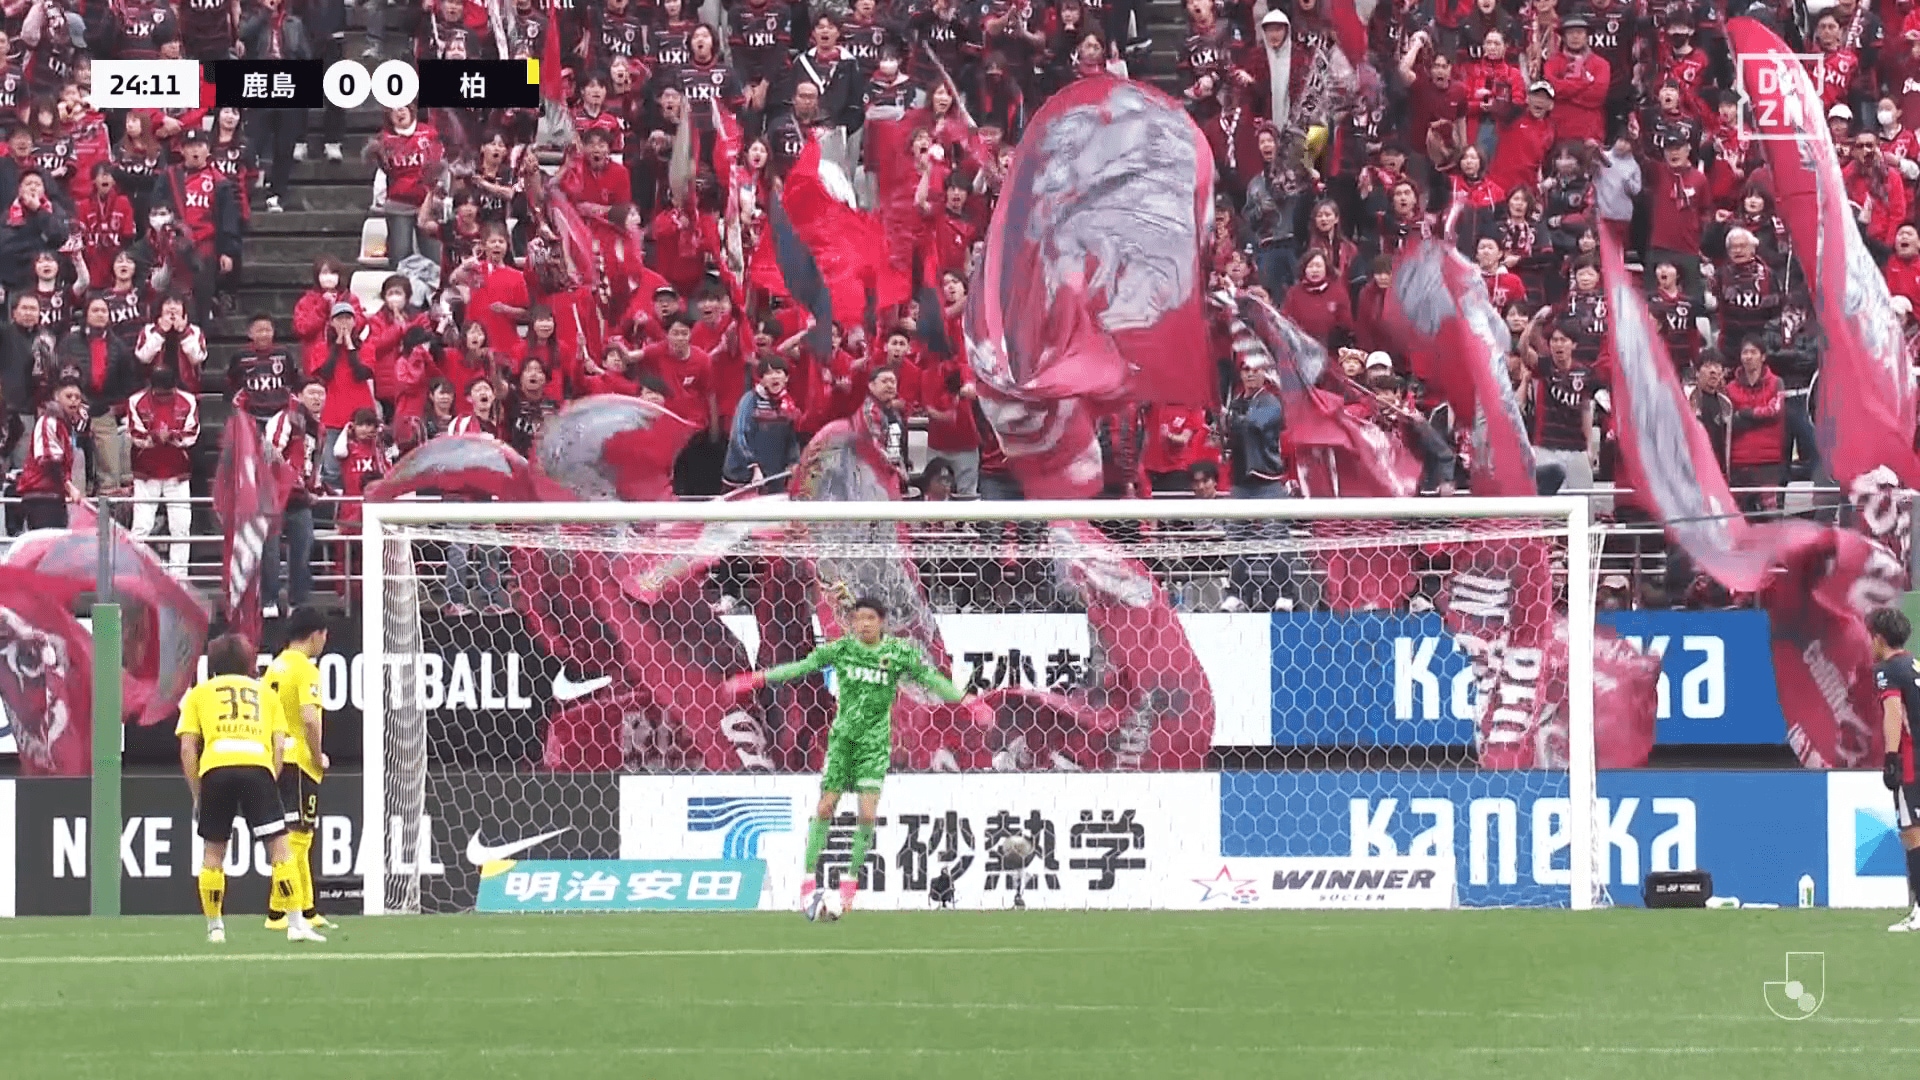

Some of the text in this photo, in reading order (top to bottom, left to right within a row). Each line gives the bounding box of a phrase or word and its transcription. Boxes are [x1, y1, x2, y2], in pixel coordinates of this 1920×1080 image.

[684, 85, 723, 99] LIXIL
[52, 816, 173, 878] NKE
[504, 869, 743, 902] 明治安田
[1271, 868, 1437, 890] WINNER
